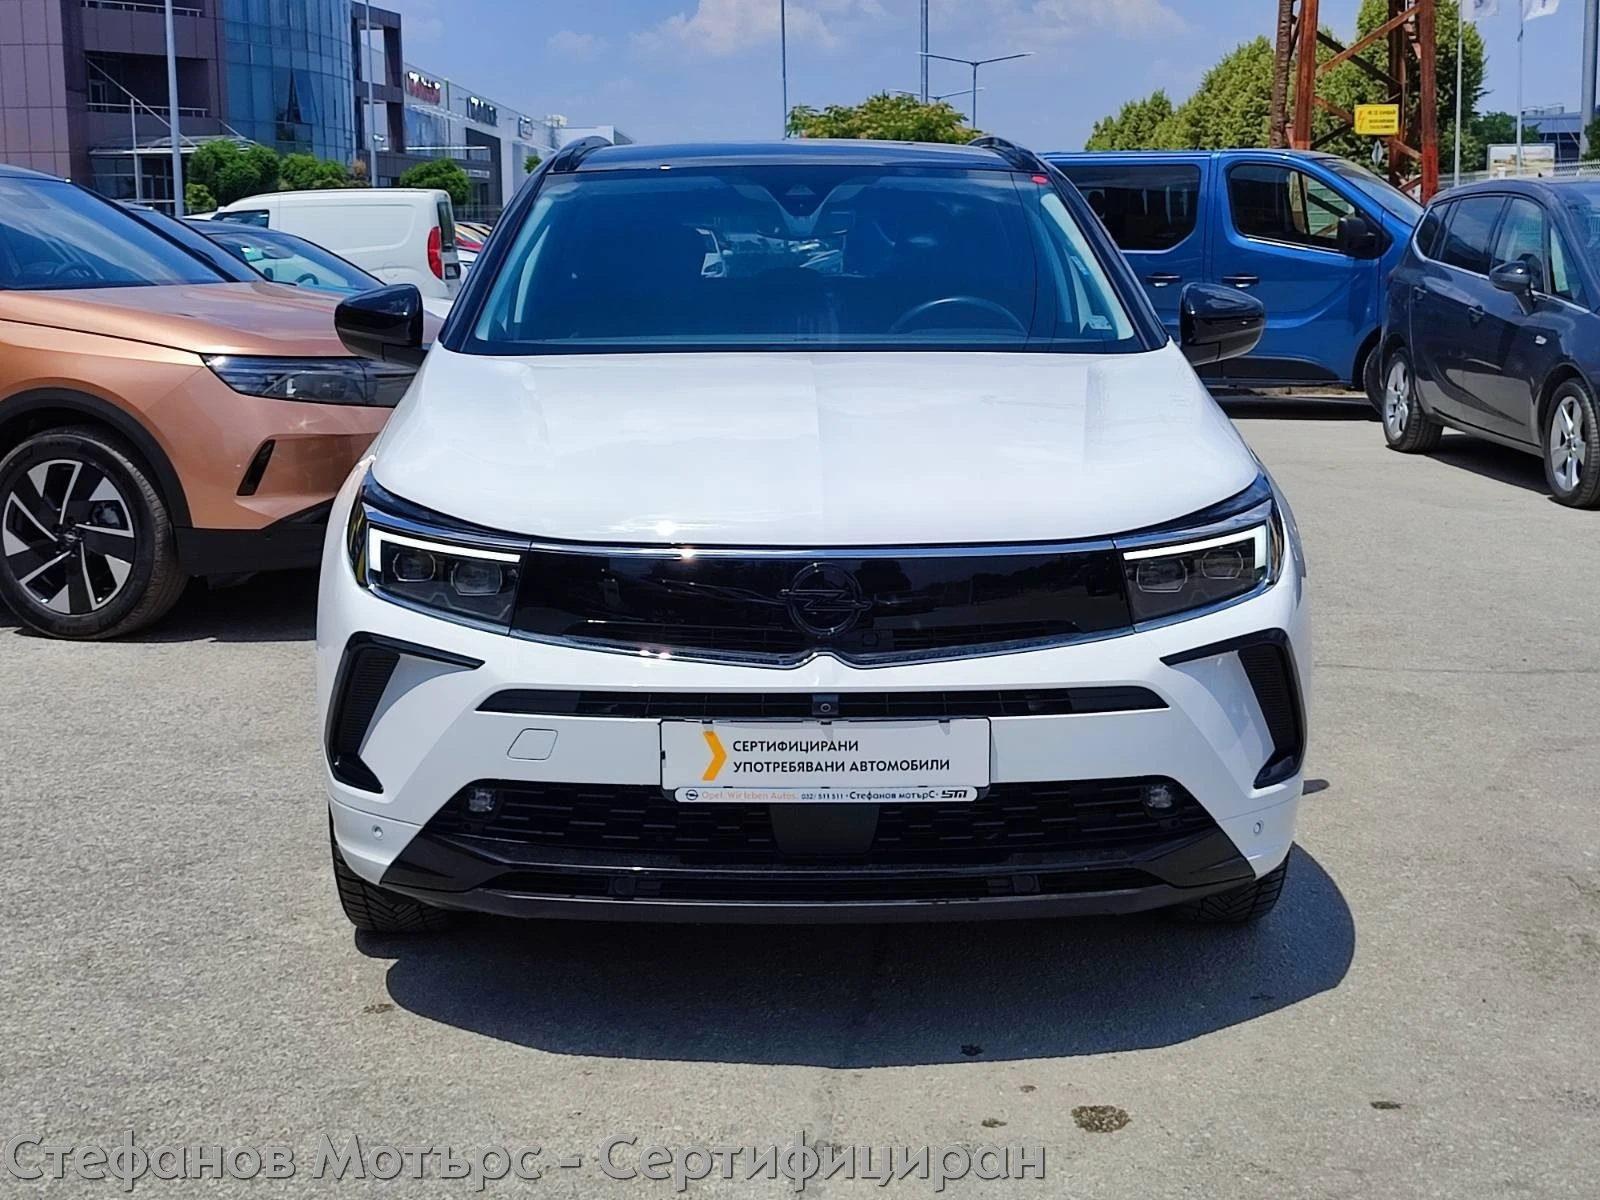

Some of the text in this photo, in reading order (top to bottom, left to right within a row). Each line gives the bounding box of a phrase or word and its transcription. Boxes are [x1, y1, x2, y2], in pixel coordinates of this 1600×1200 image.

[733, 740, 859, 754] СЕРТИФИЦИРАНИ
[733, 759, 951, 773] УПОТРЕБЯВАНИ АВТОМОБИЛИ
[743, 791, 768, 799] leben
[849, 791, 897, 800] Стефанов
